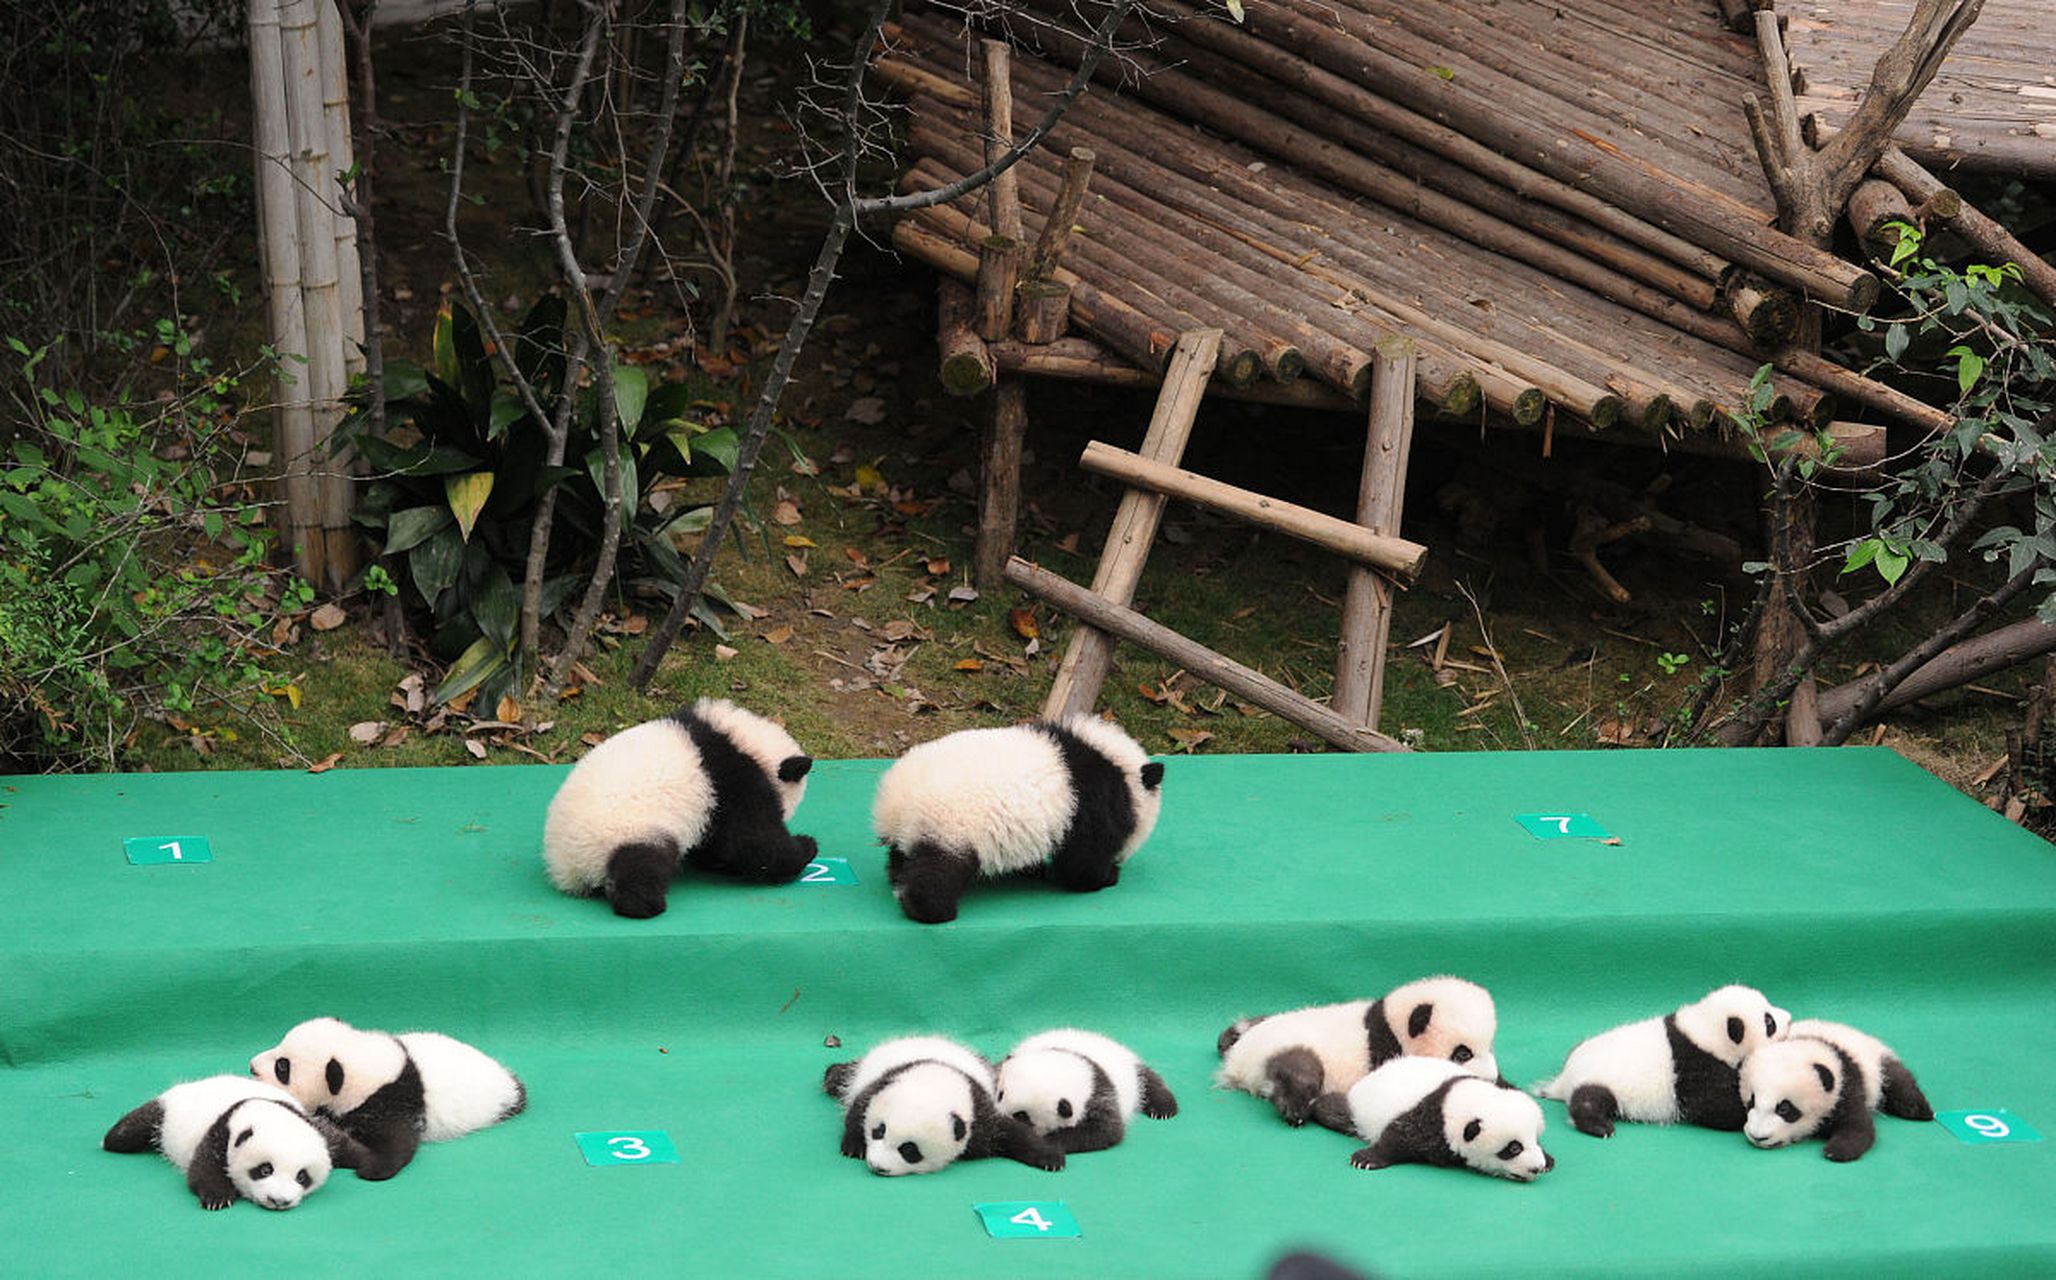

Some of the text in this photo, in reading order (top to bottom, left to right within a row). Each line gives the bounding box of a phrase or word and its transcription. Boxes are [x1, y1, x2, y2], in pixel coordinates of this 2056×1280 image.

[1540, 816, 1571, 834] 7
[159, 842, 182, 860] 1
[801, 864, 836, 882] 2
[1965, 1115, 2009, 1138] 9
[608, 1136, 650, 1159] 3
[1010, 1208, 1053, 1231] 4
